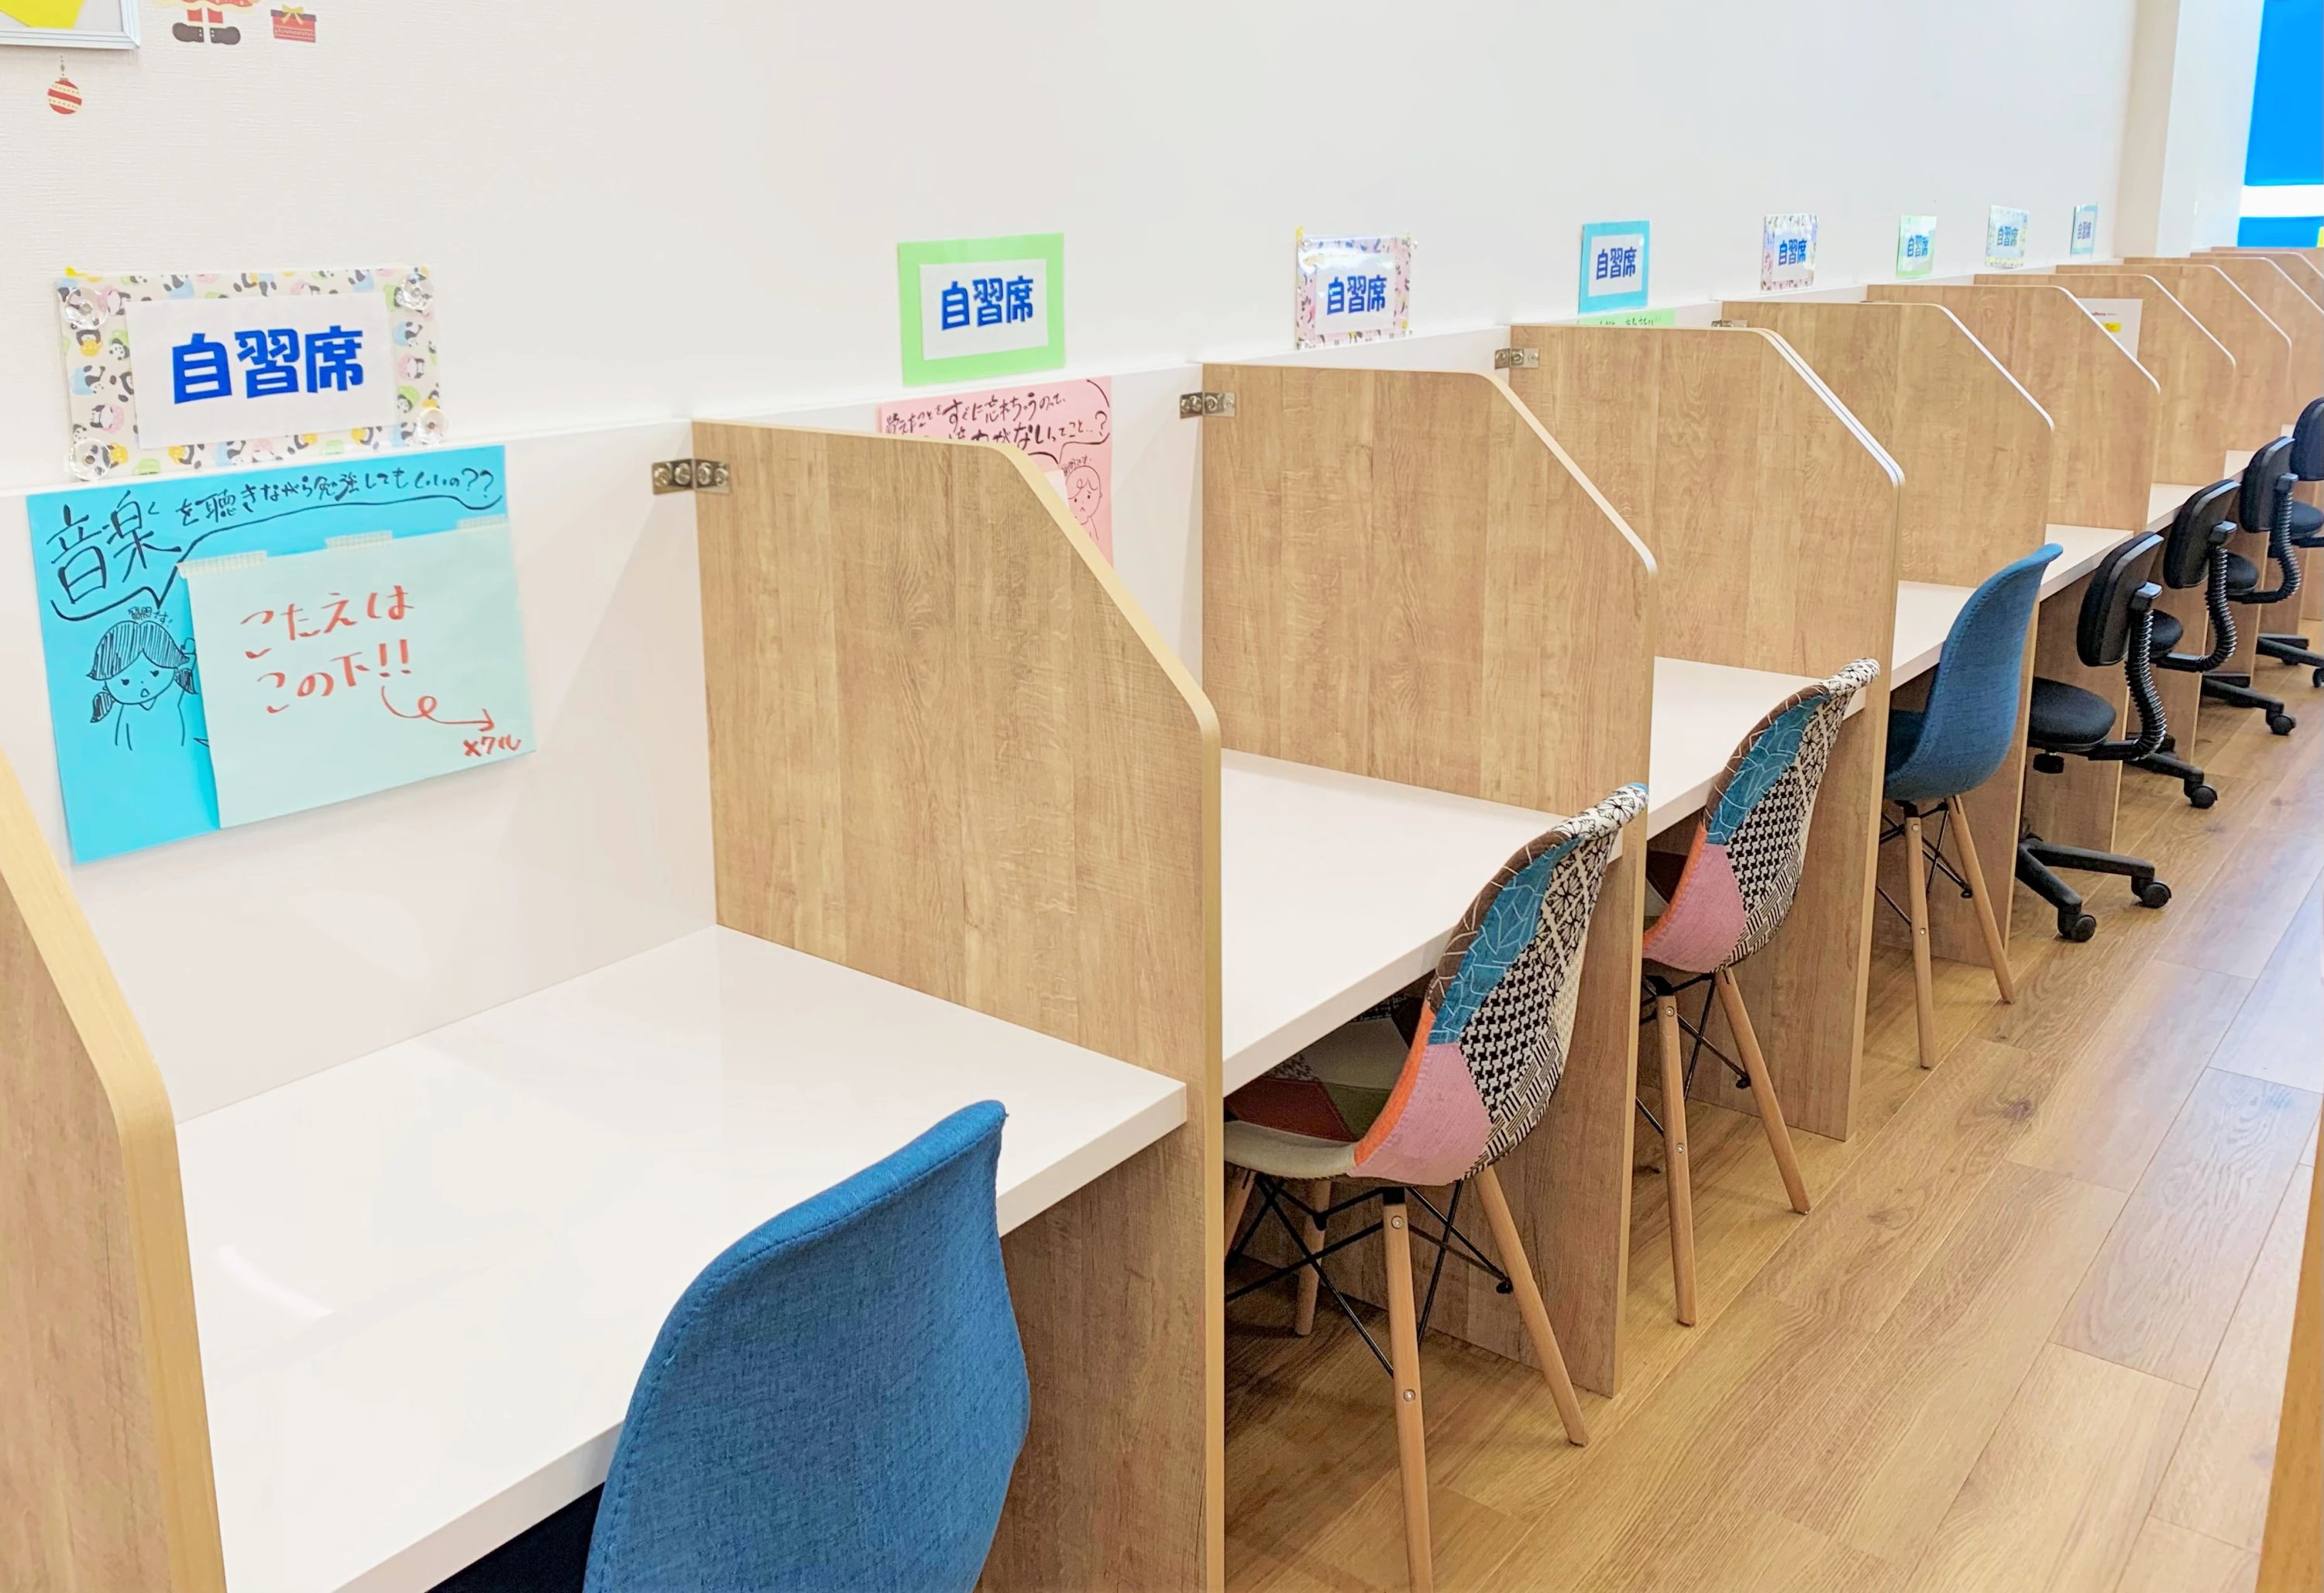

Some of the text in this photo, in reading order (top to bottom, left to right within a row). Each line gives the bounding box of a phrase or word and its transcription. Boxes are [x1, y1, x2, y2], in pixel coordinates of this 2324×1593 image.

[1778, 238, 1807, 267] 自習席
[1906, 234, 1929, 257] 自習席
[1996, 225, 2019, 247] 自習席
[1596, 247, 1636, 280] 自習席
[941, 275, 1034, 331] 自習席
[1327, 274, 1386, 315] 自習席
[172, 325, 364, 404] 自習席
[239, 585, 414, 659] こたえは
[256, 638, 411, 714] この下!!
